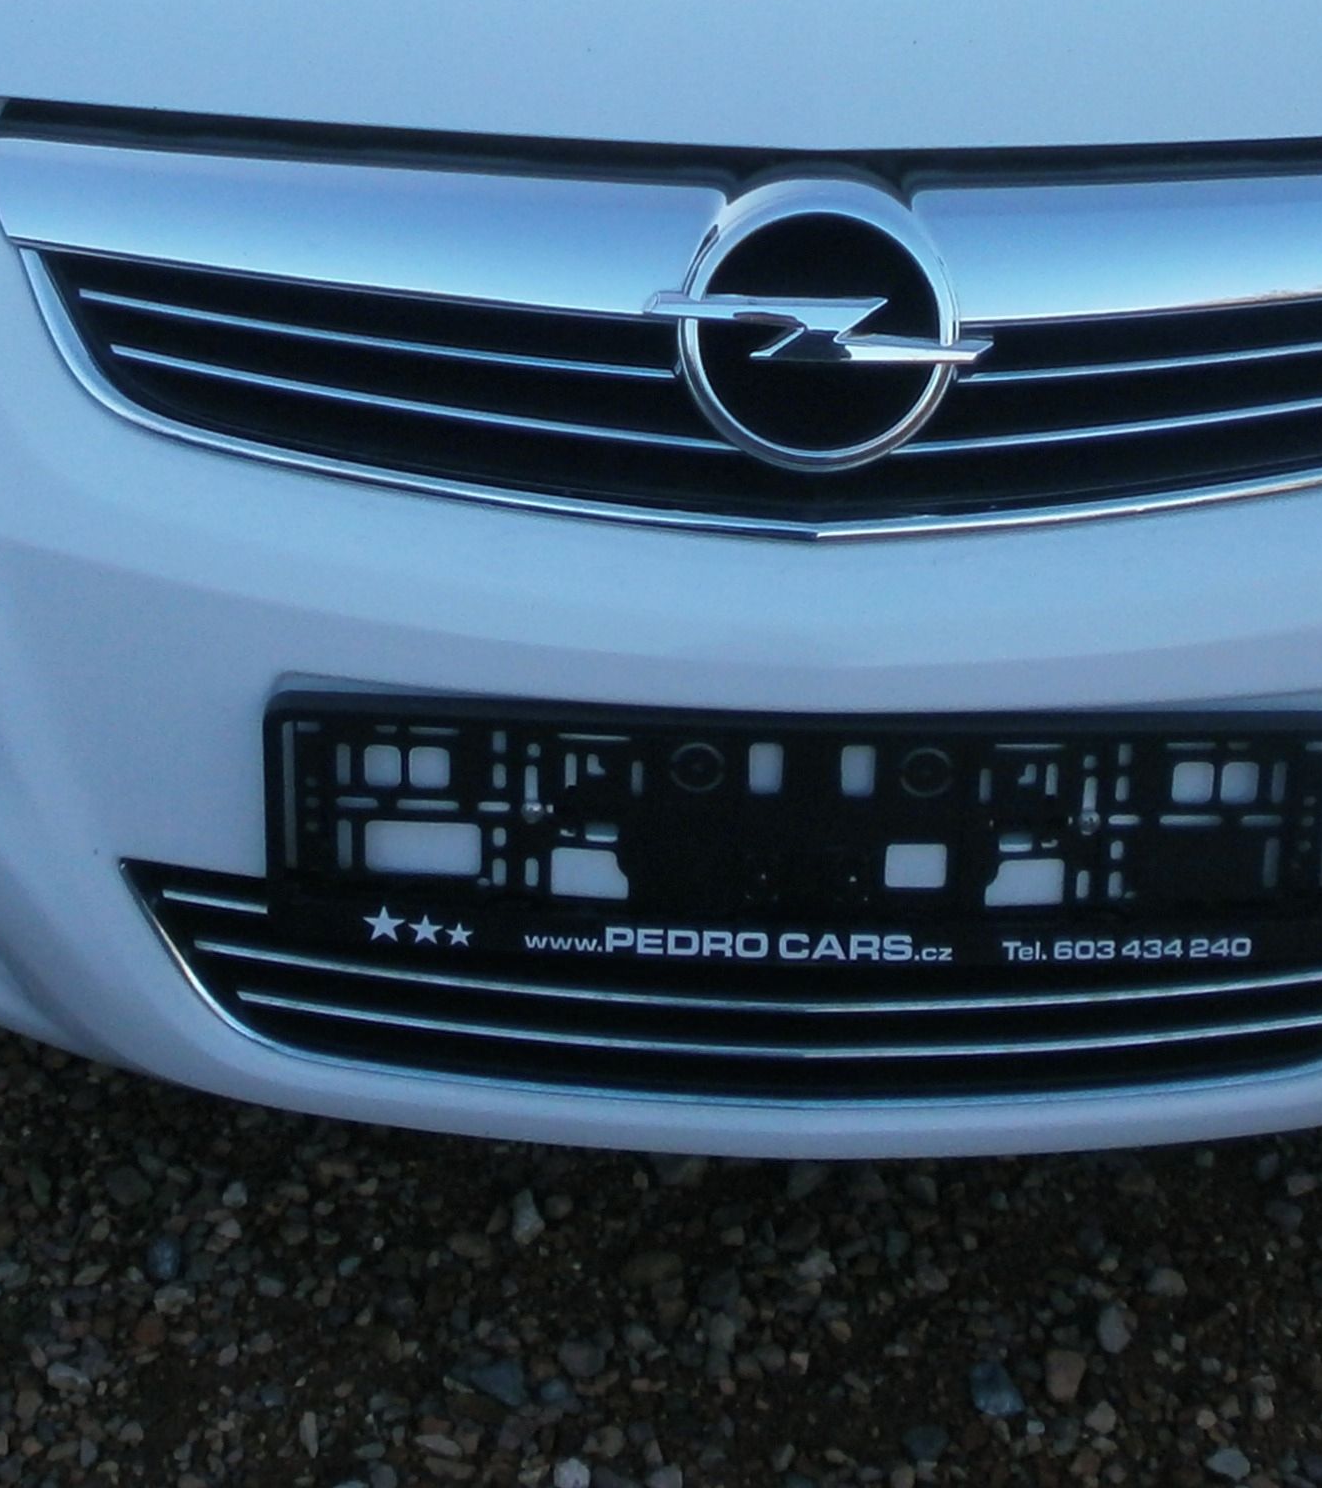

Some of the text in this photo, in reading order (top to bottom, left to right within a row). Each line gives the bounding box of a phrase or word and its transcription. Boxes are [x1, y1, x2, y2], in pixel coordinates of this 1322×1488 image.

[778, 932, 953, 961] CARS.cz
[1002, 940, 1047, 961] Tel.
[1053, 940, 1115, 960] 603
[1121, 939, 1183, 959] 434
[1189, 937, 1252, 958] 240
